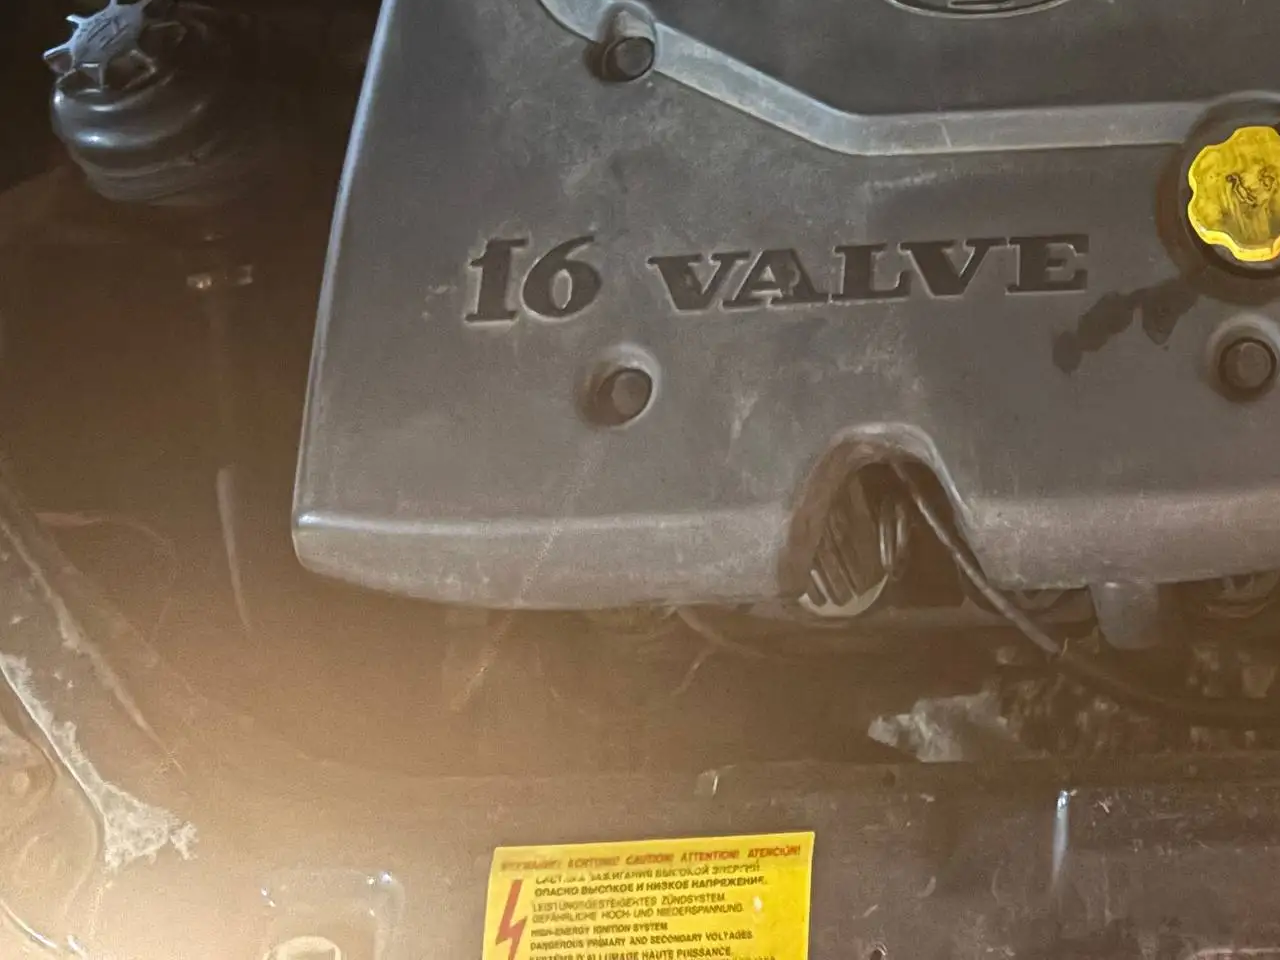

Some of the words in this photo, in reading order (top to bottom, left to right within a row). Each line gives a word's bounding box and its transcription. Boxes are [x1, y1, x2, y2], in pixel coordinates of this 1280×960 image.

[464, 235, 602, 324] 16
[648, 233, 1092, 314] VALVE
[534, 886, 579, 898] ОПАСНО
[646, 880, 689, 891] НИЗКОЕ
[629, 935, 648, 945] AND
